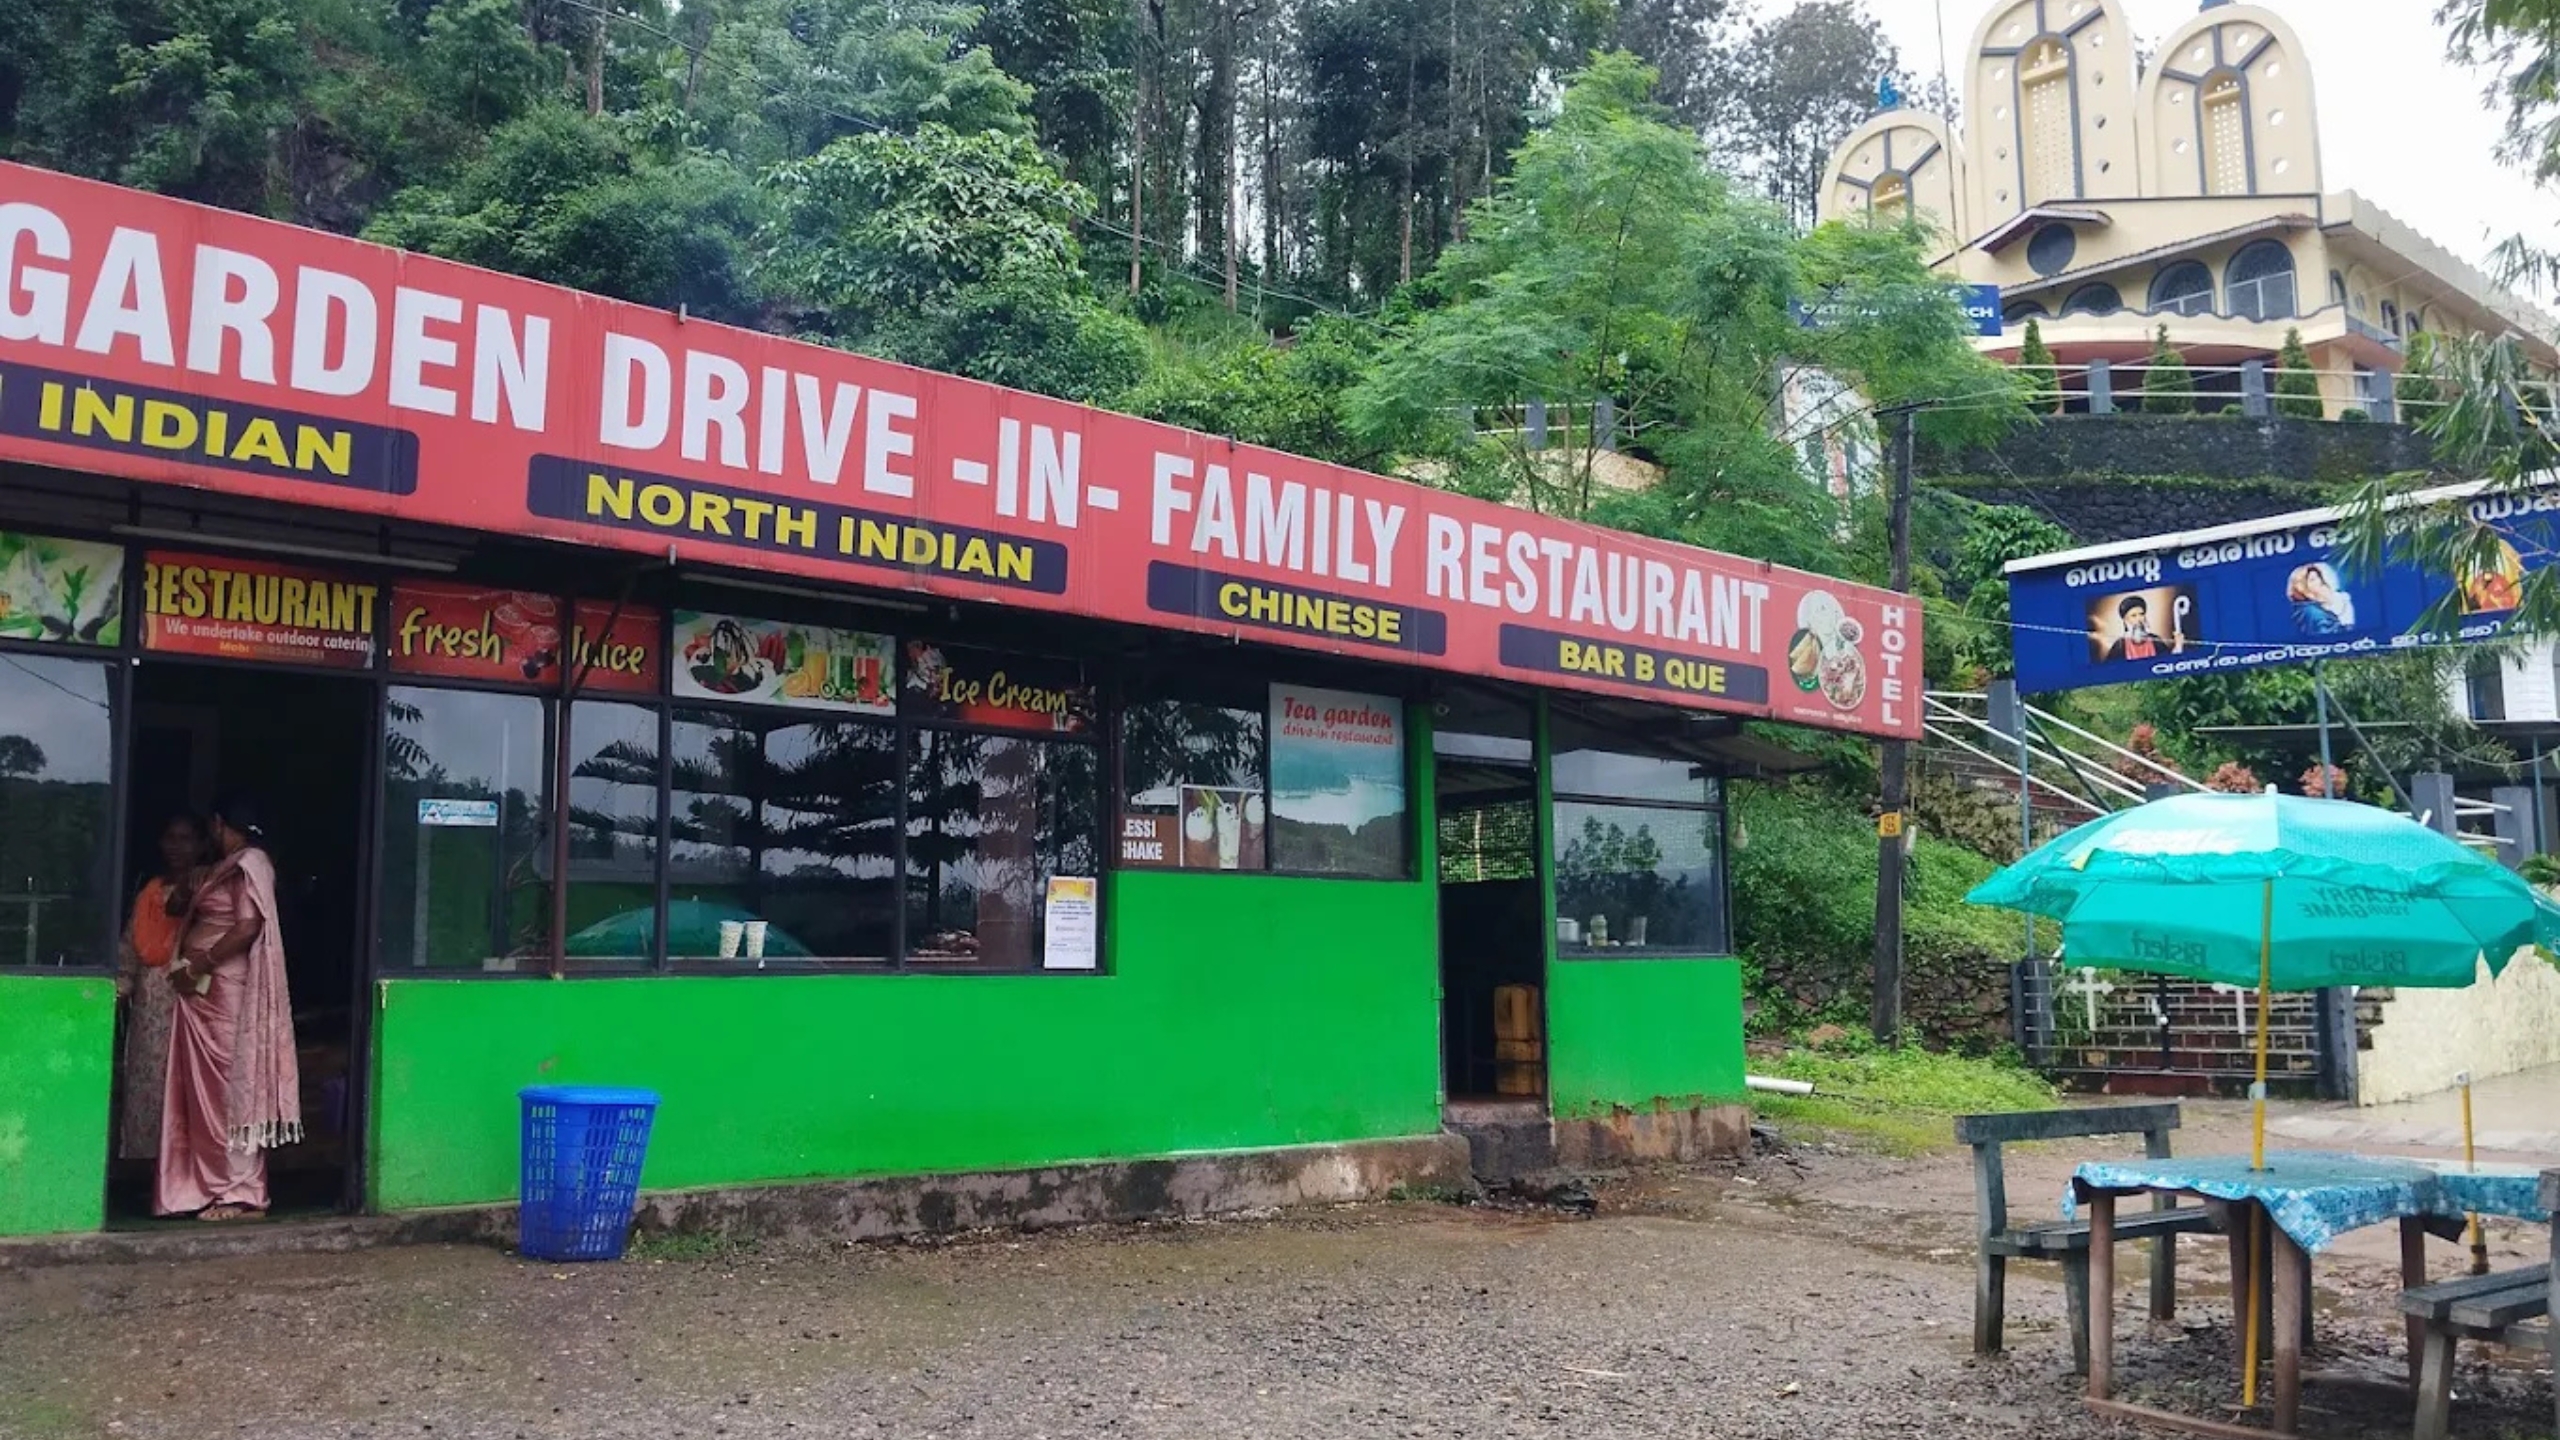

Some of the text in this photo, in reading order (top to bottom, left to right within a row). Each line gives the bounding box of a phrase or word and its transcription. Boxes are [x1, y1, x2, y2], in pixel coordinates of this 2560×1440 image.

[0, 202, 550, 433] GARDEN
[600, 332, 917, 498] DRIVE
[1151, 451, 1405, 588] FAMILY
[1426, 513, 1769, 653] RESTAURANT
[38, 381, 352, 477] INDIAN
[586, 474, 1033, 582] NORTH INDIAN
[144, 562, 378, 634] RESTAURANT
[1220, 582, 1401, 644] CHINESE
[165, 618, 188, 635] We
[193, 622, 263, 642] undertake
[267, 628, 319, 647] outdoor
[939, 666, 1068, 715] Ice Cream
[1559, 640, 1726, 694] BAR B QUE
[1881, 604, 1905, 727] HOTEL
[1283, 696, 1393, 729] Tea garden
[1122, 818, 1157, 838] ESSI
